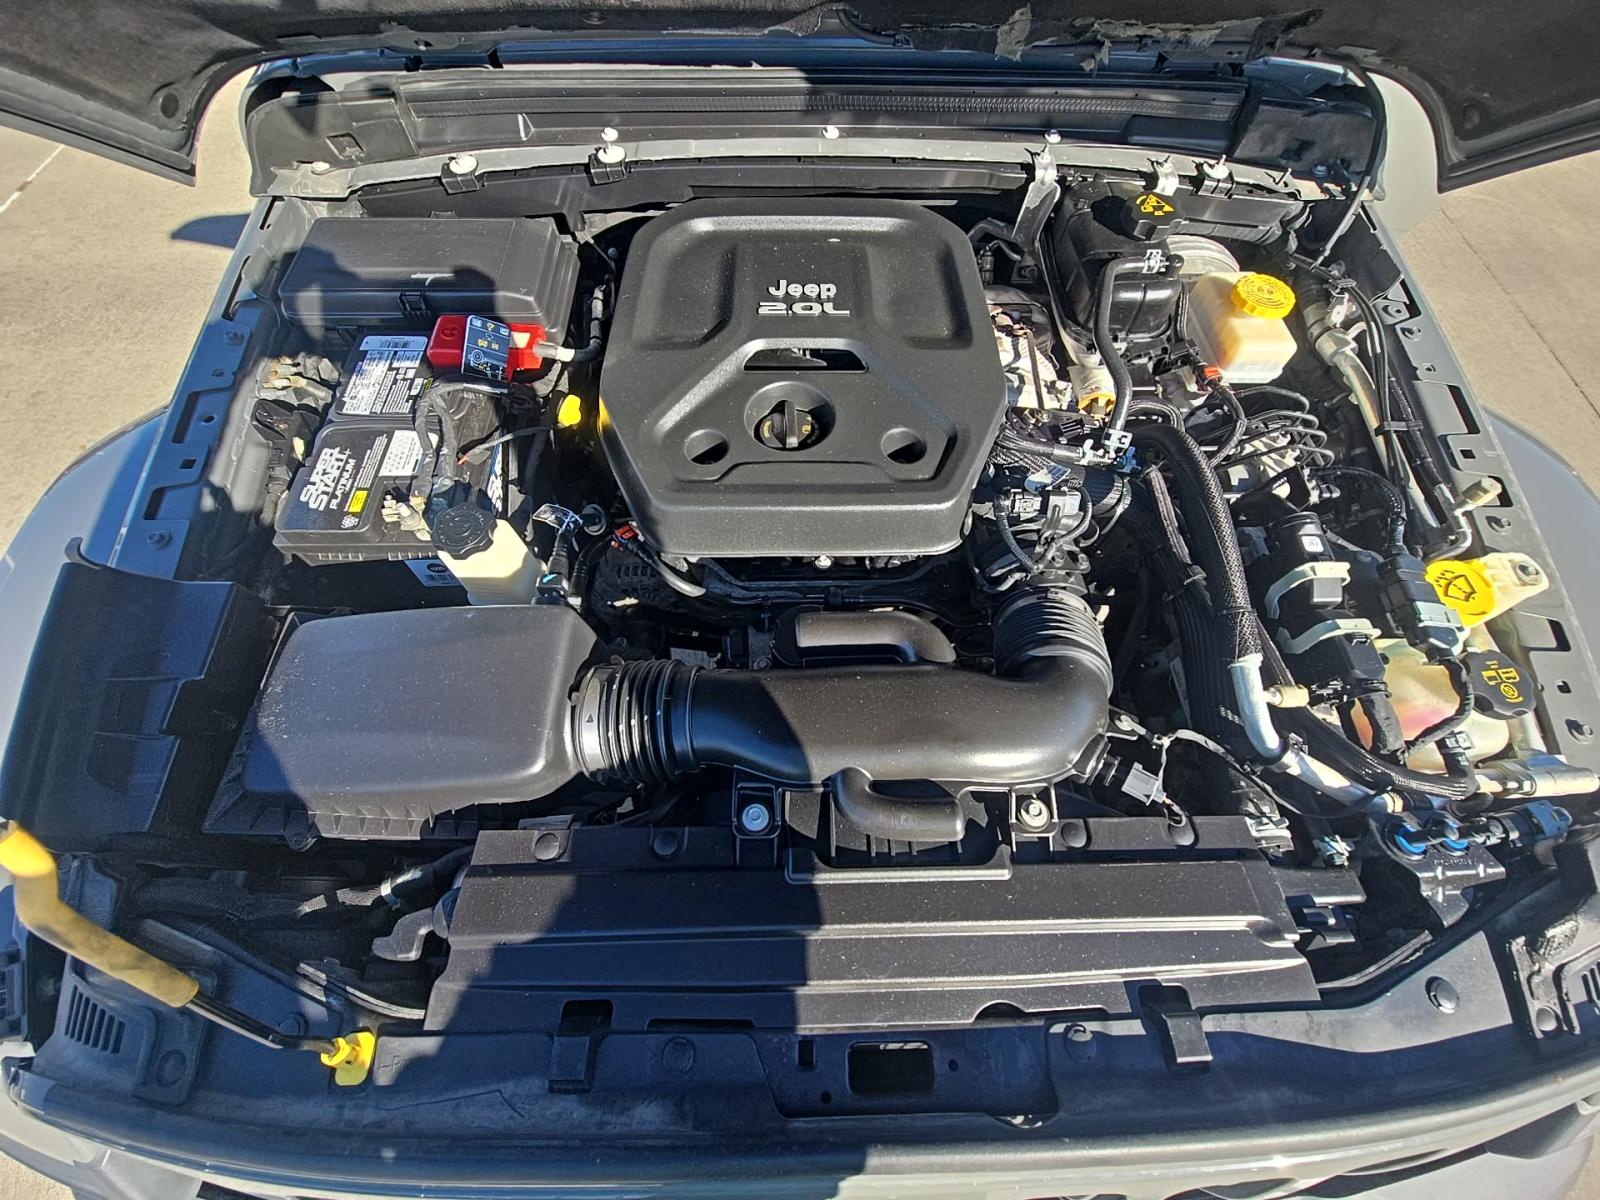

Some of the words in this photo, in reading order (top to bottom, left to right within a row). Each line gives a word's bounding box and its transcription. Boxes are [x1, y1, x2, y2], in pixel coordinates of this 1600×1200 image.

[758, 302, 850, 316] 2.0L
[768, 279, 837, 299] Jeep
[300, 447, 336, 503] SUPER
[308, 446, 350, 511] START
[328, 458, 356, 510] PLATINUM
